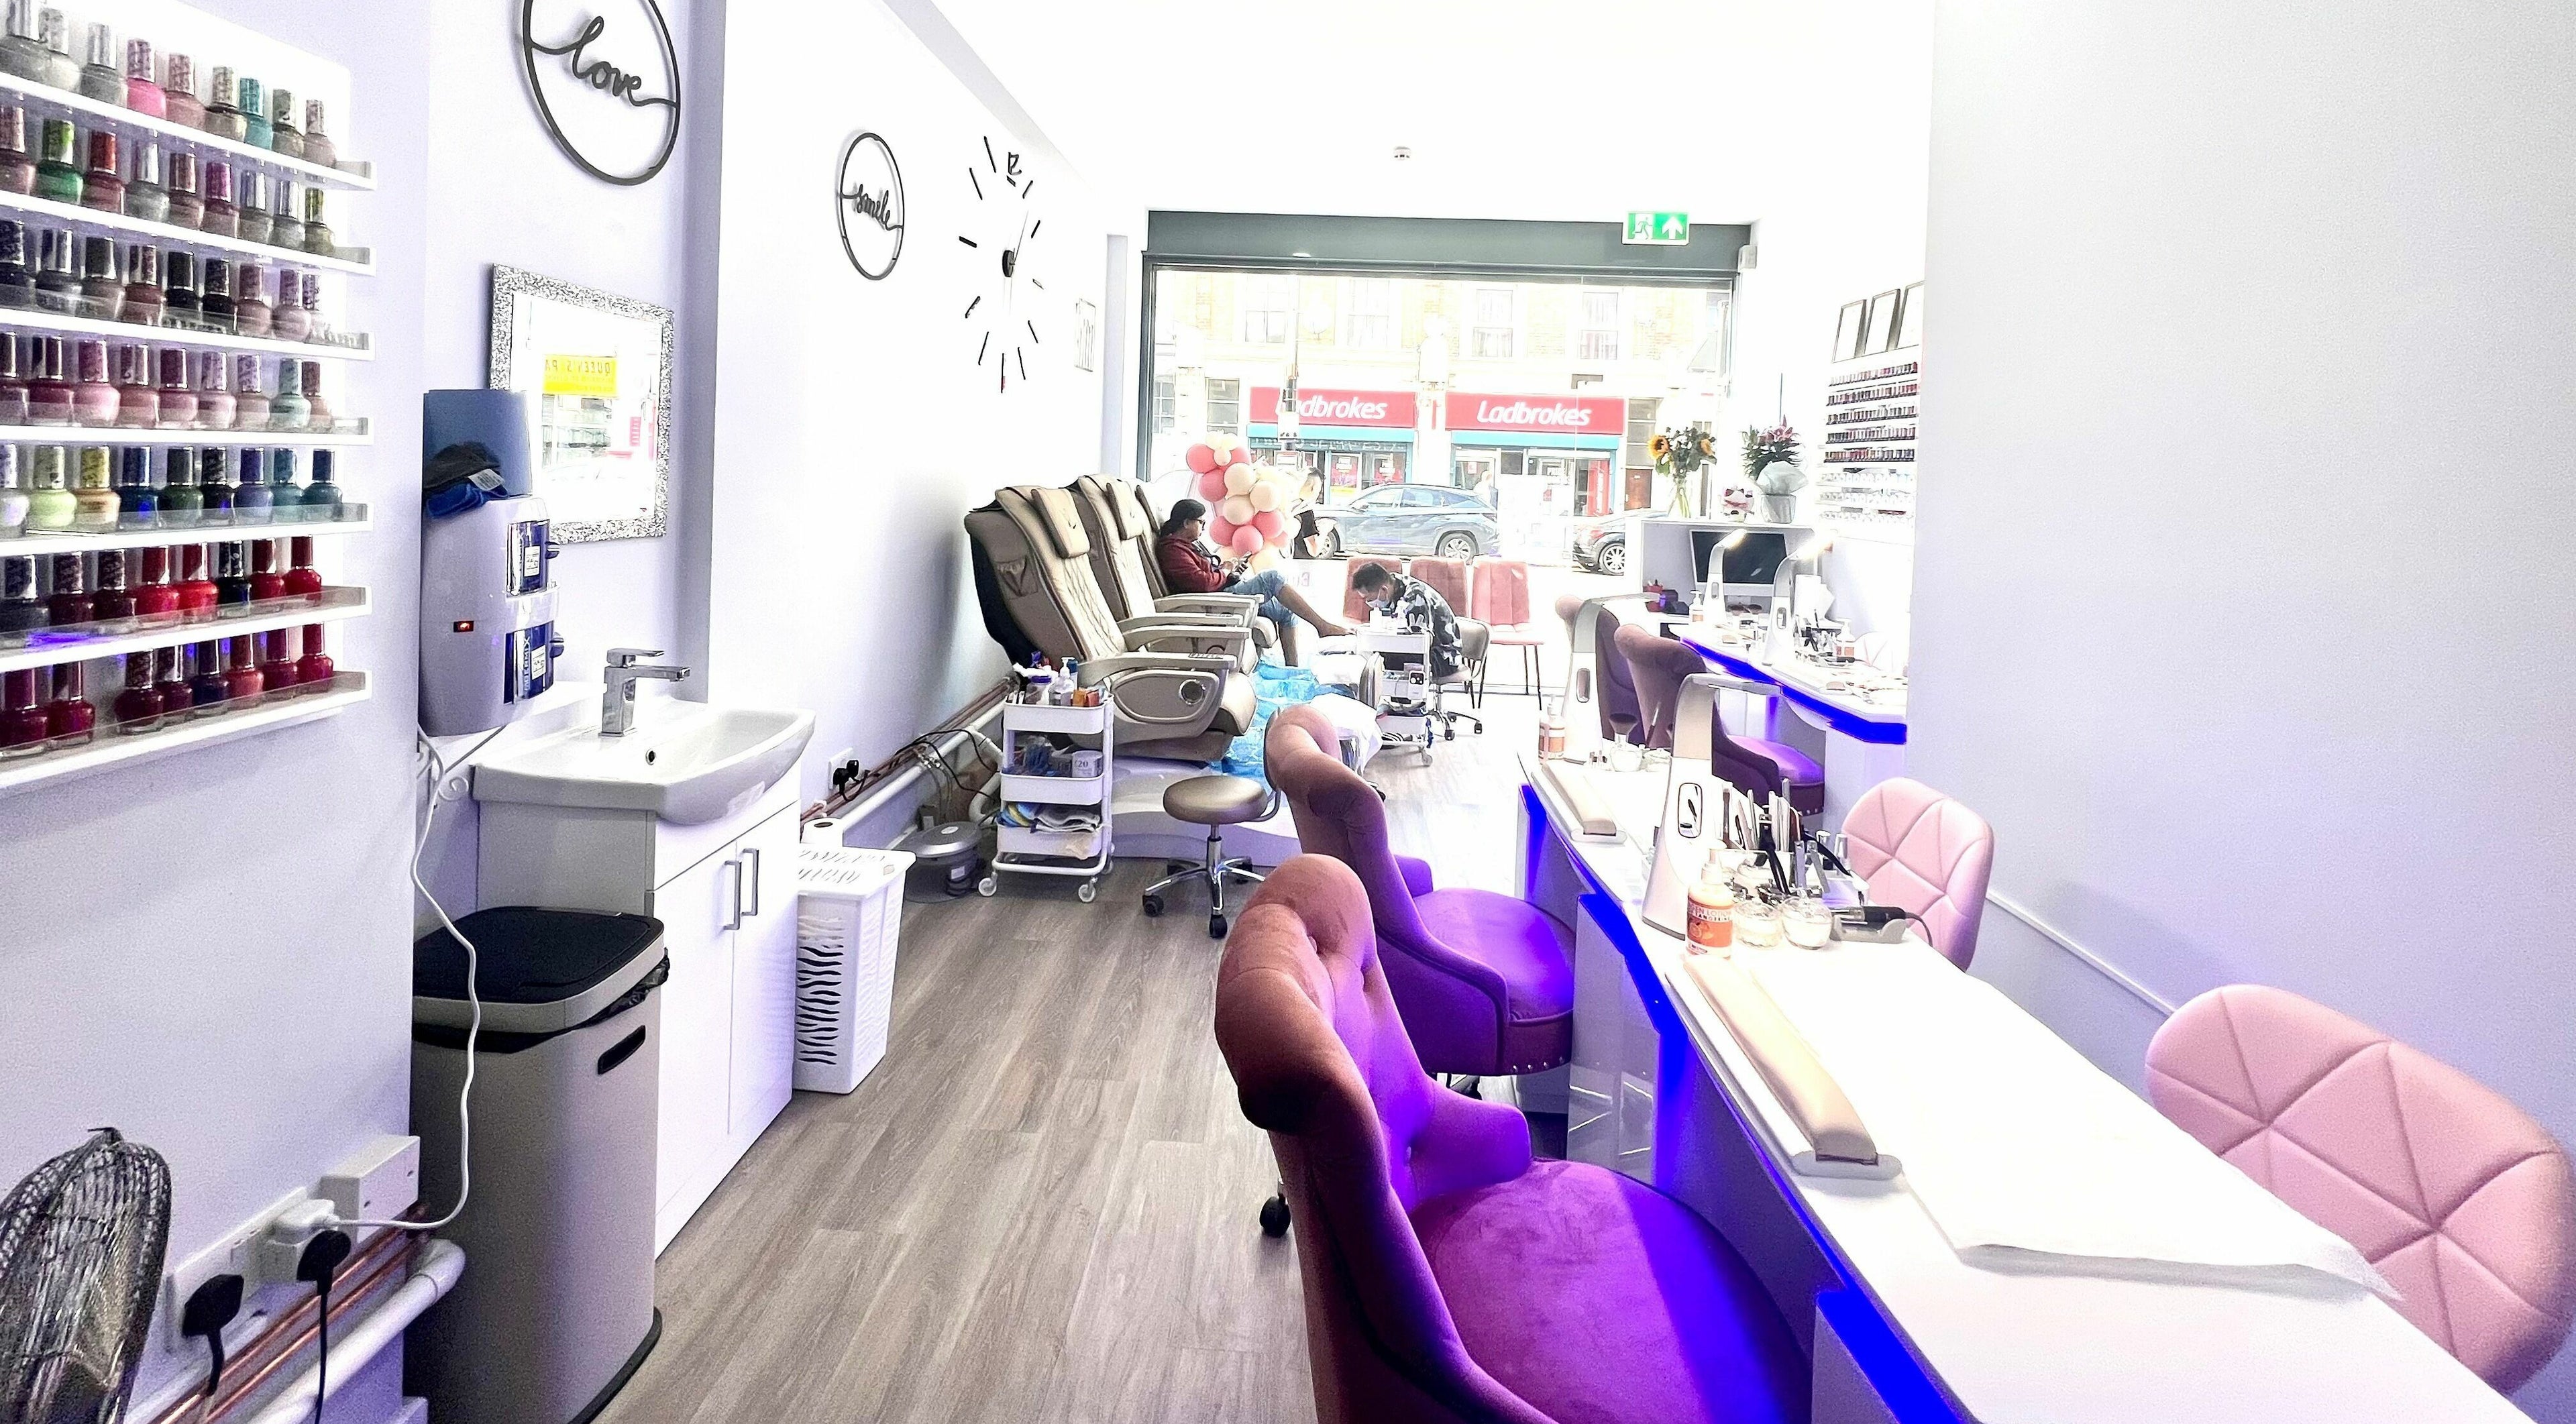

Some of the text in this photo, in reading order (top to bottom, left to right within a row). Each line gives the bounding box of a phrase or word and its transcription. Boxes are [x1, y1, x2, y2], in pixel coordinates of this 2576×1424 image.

[555, 16, 661, 106] love
[851, 183, 898, 231] smile
[1477, 400, 1593, 426] Ladbrokes
